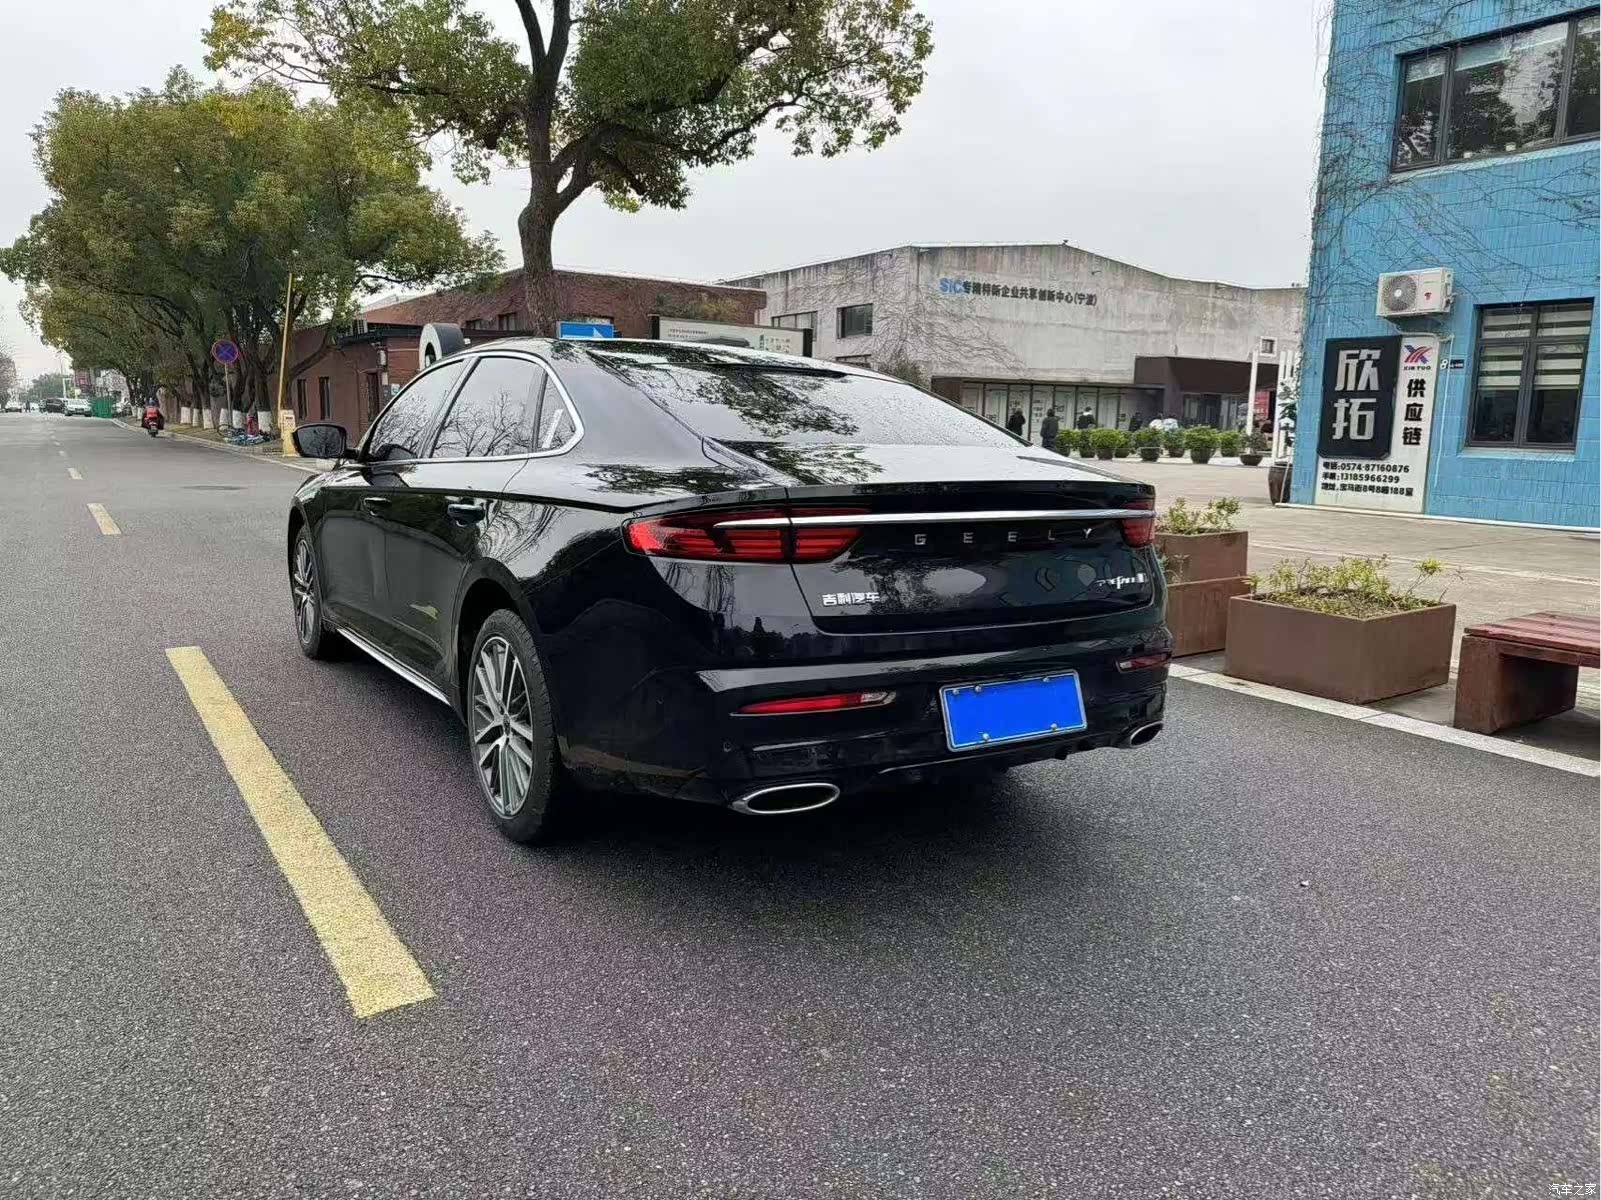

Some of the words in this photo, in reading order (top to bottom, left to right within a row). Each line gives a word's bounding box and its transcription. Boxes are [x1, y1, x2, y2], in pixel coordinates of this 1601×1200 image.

[1332, 349, 1382, 441] 欣拓
[1402, 378, 1426, 446] 供应链
[914, 527, 1093, 546] GEELY
